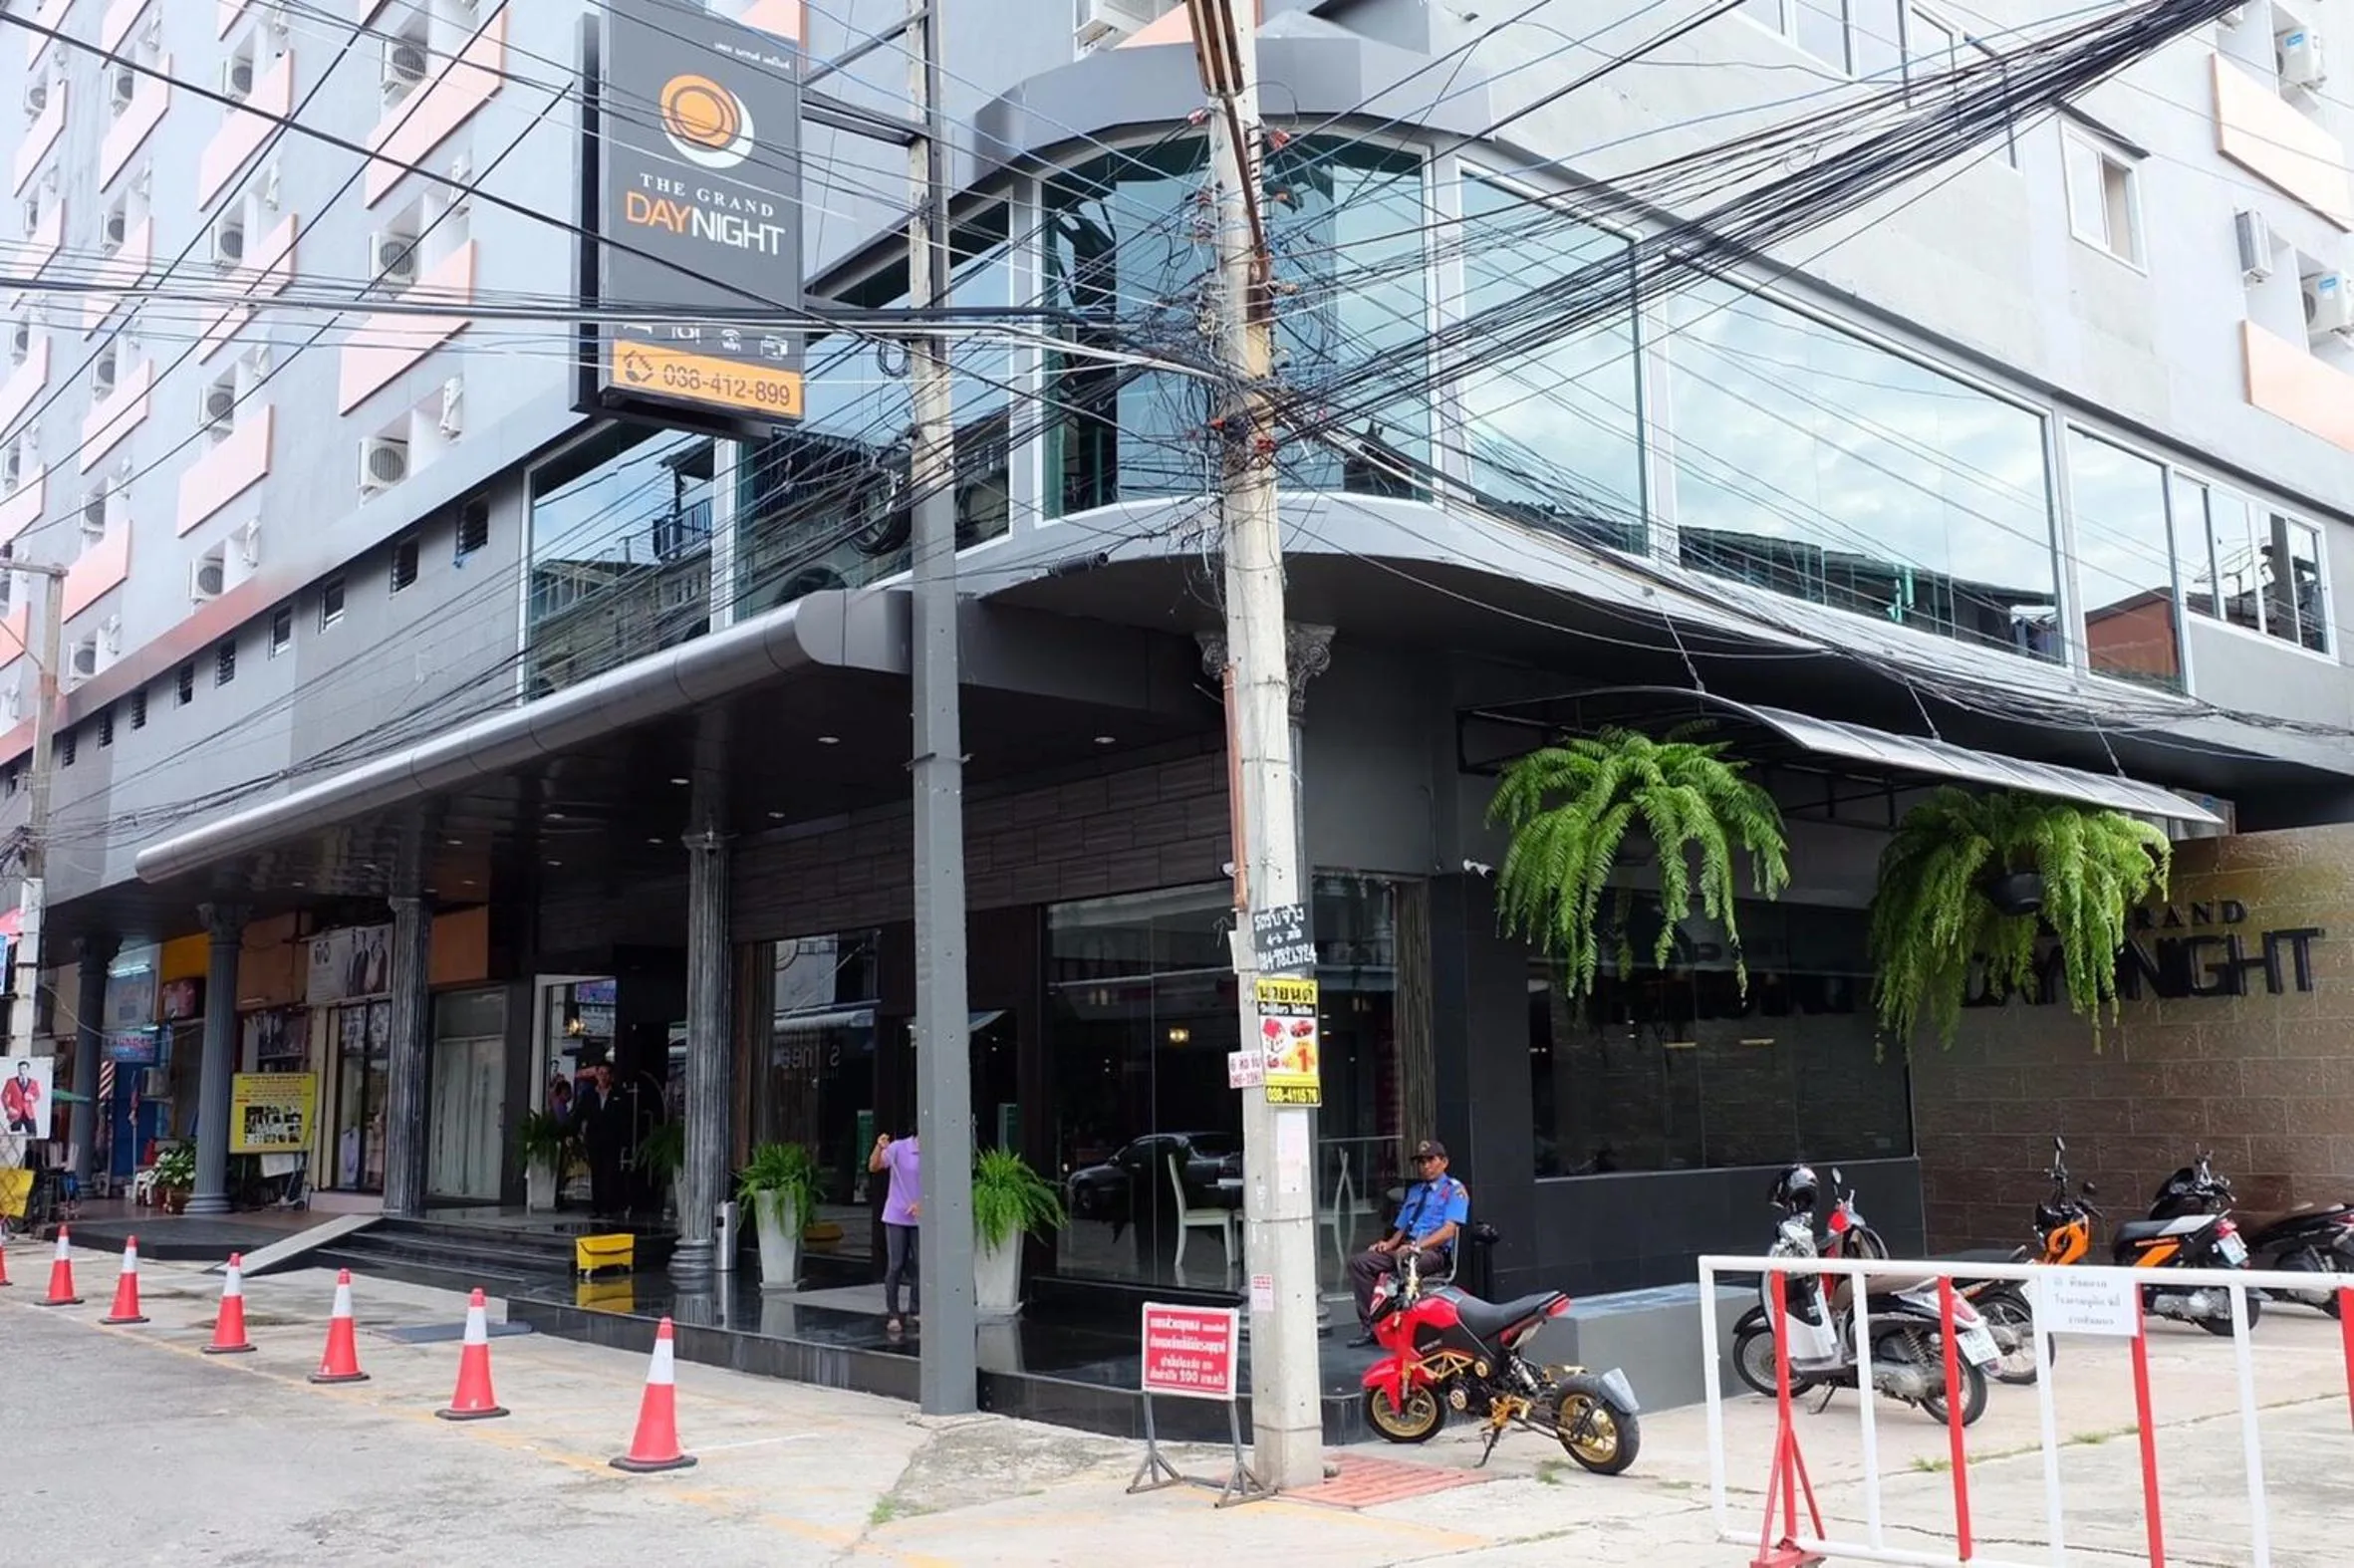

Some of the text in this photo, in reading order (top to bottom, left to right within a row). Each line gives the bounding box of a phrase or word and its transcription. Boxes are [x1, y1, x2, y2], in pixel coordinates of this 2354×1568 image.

[640, 173, 774, 218] THE GRAND
[662, 363, 791, 407] 038-412-899
[2130, 900, 2248, 930] RAND
